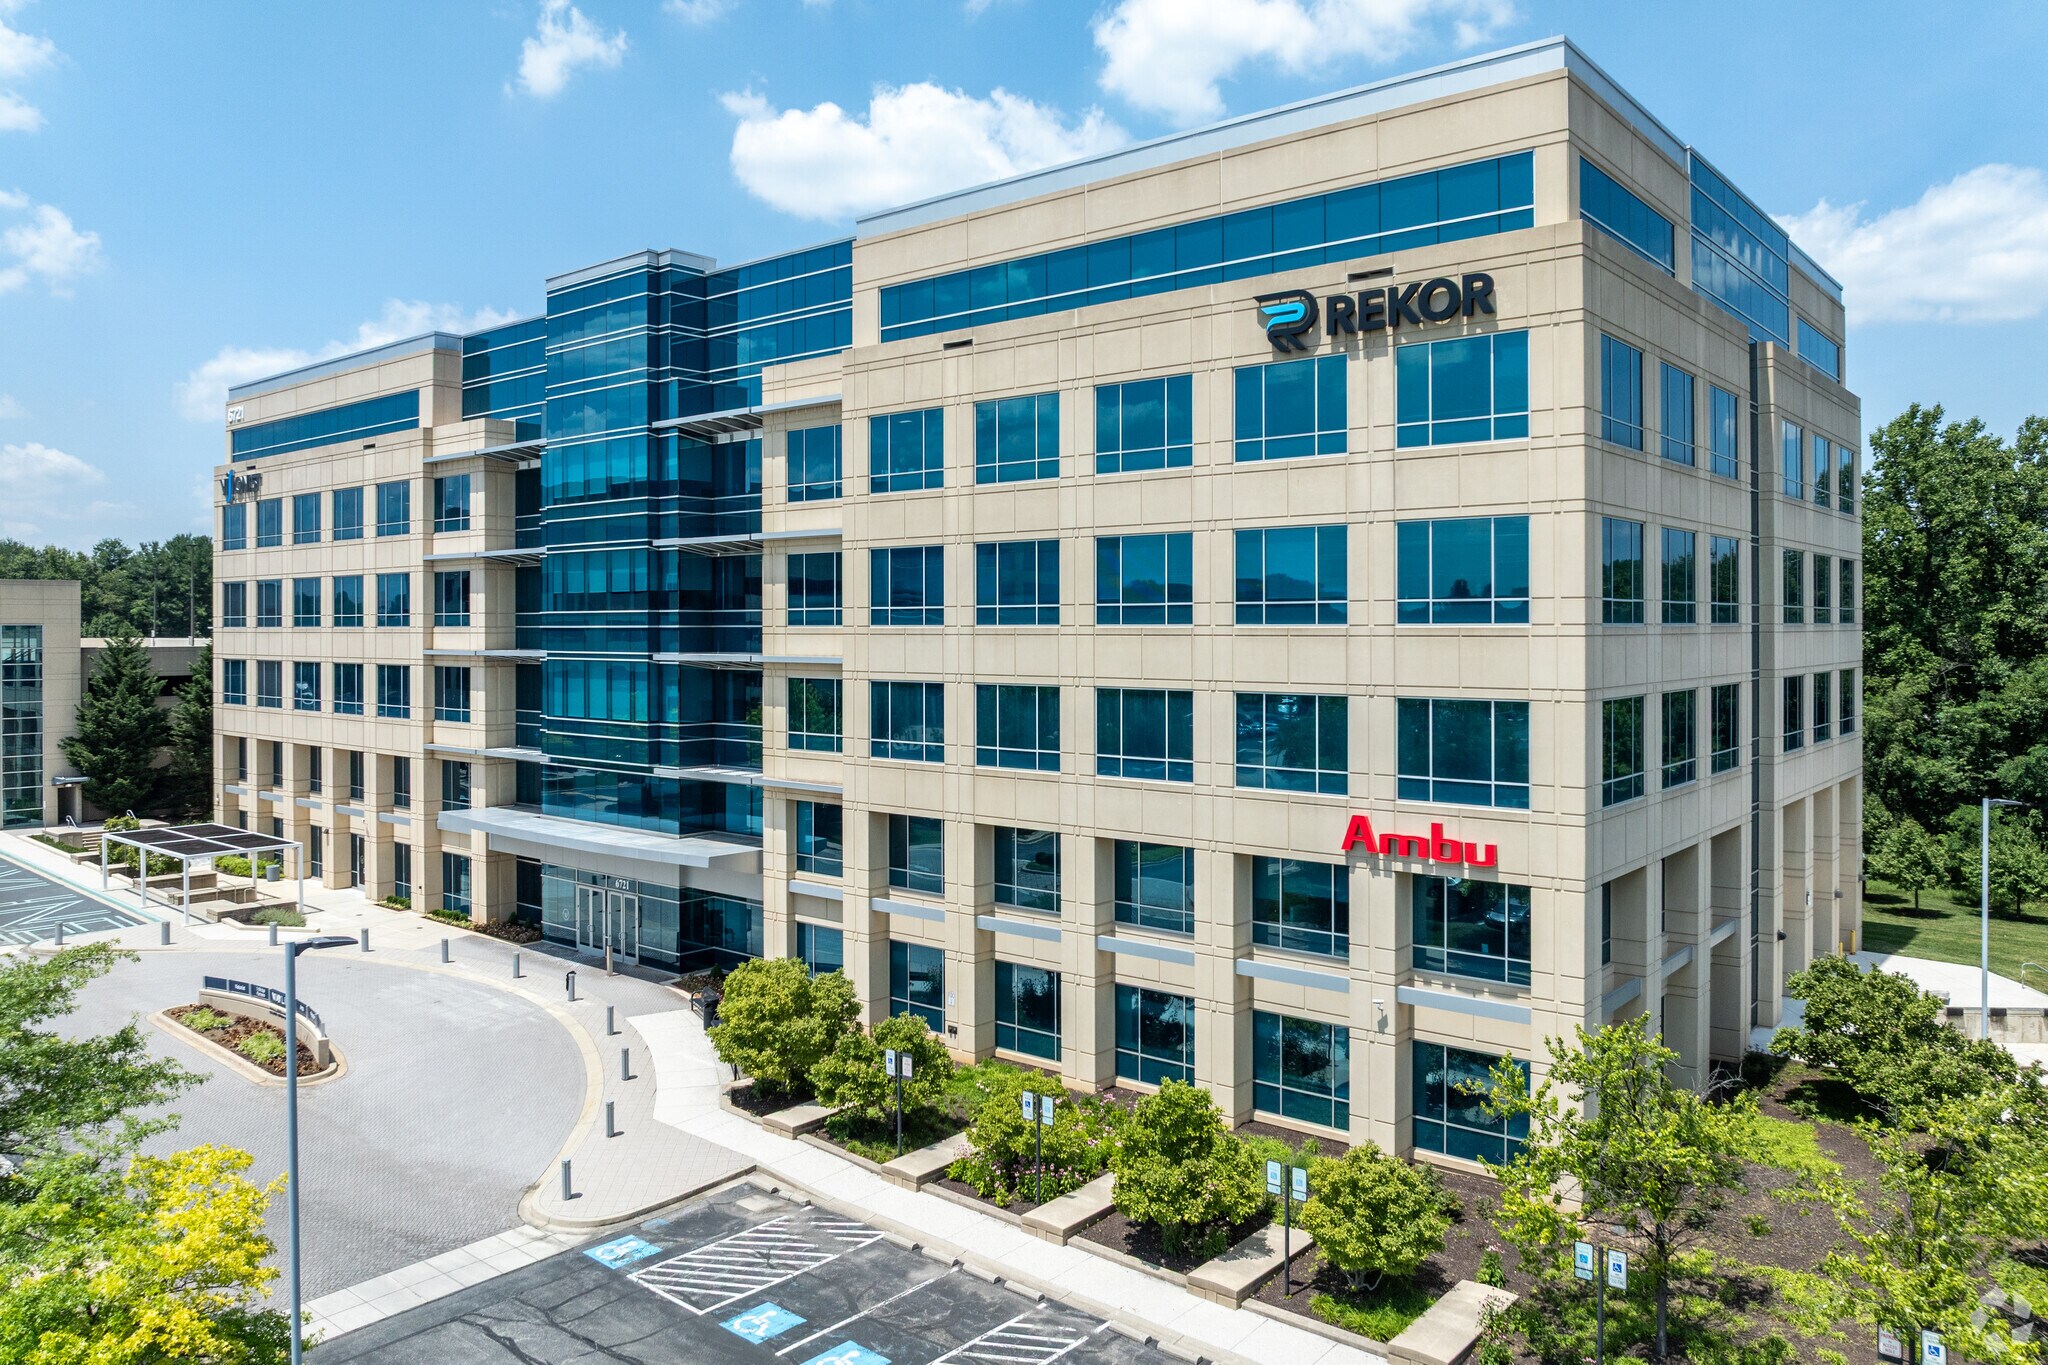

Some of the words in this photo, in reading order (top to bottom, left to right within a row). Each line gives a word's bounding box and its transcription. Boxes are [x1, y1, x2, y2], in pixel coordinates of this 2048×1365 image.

[1326, 272, 1495, 336] REKOR
[228, 405, 244, 422] 6721
[1341, 814, 1498, 867] Ambu
[615, 878, 629, 890] 6721
